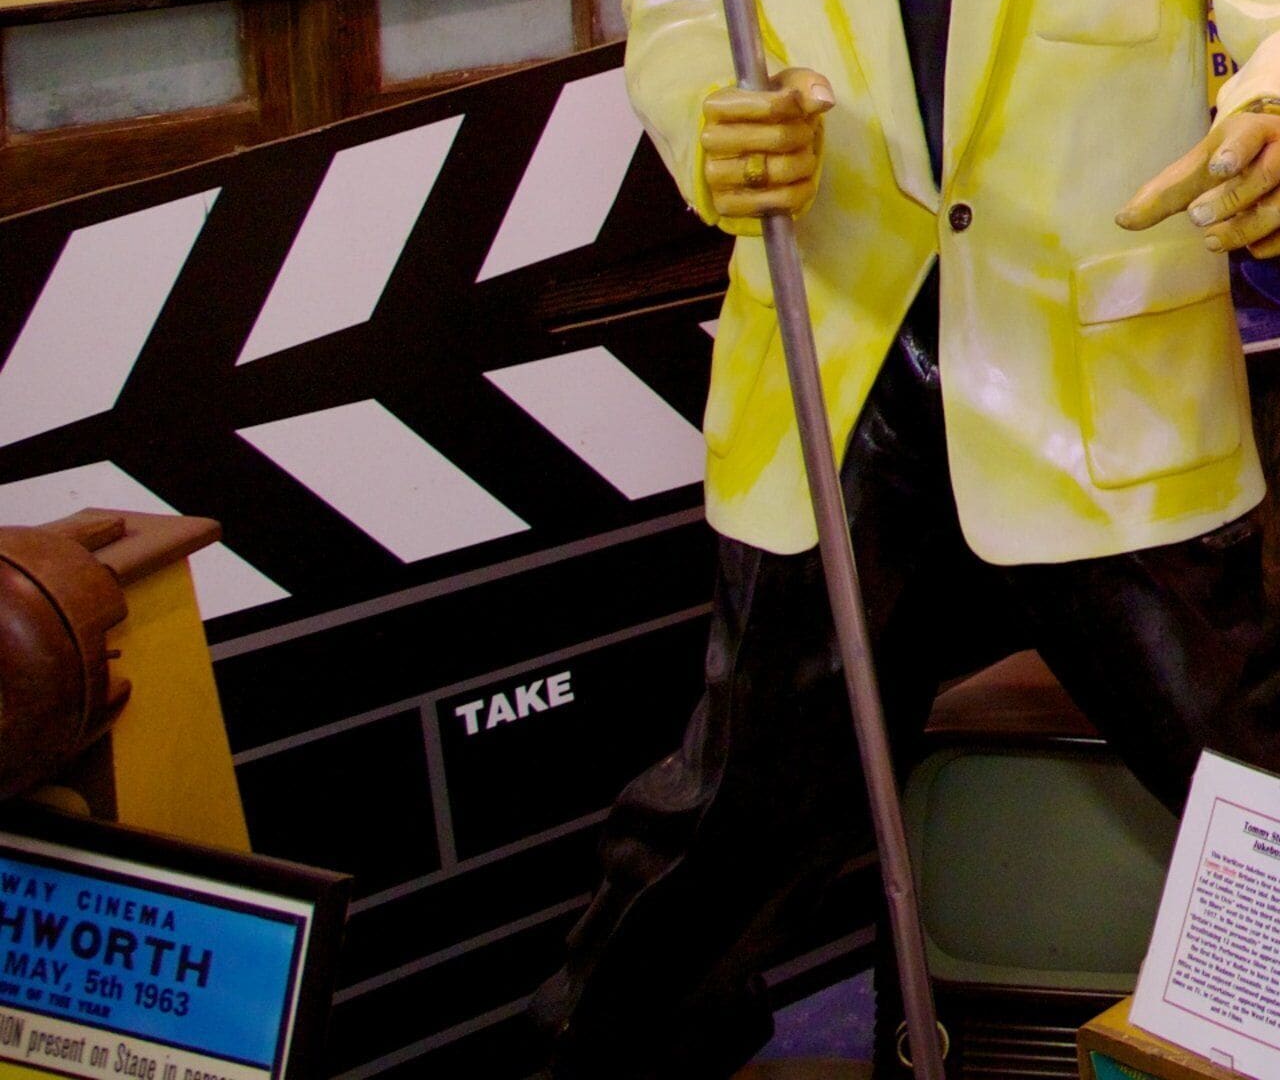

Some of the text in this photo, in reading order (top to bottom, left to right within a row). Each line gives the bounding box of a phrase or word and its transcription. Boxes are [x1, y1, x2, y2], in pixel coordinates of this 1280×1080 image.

[455, 670, 575, 735] TAKE
[1243, 821, 1270, 839] Tommy
[77, 891, 176, 932] CINEMA
[4, 951, 191, 1017] MAY, 5th 1963
[27, 987, 43, 1002] OF
[48, 992, 73, 1009] THE
[78, 998, 113, 1019] YEAR
[27, 1027, 88, 1065] present
[89, 1044, 110, 1069] on
[114, 1043, 158, 1080] Stage
